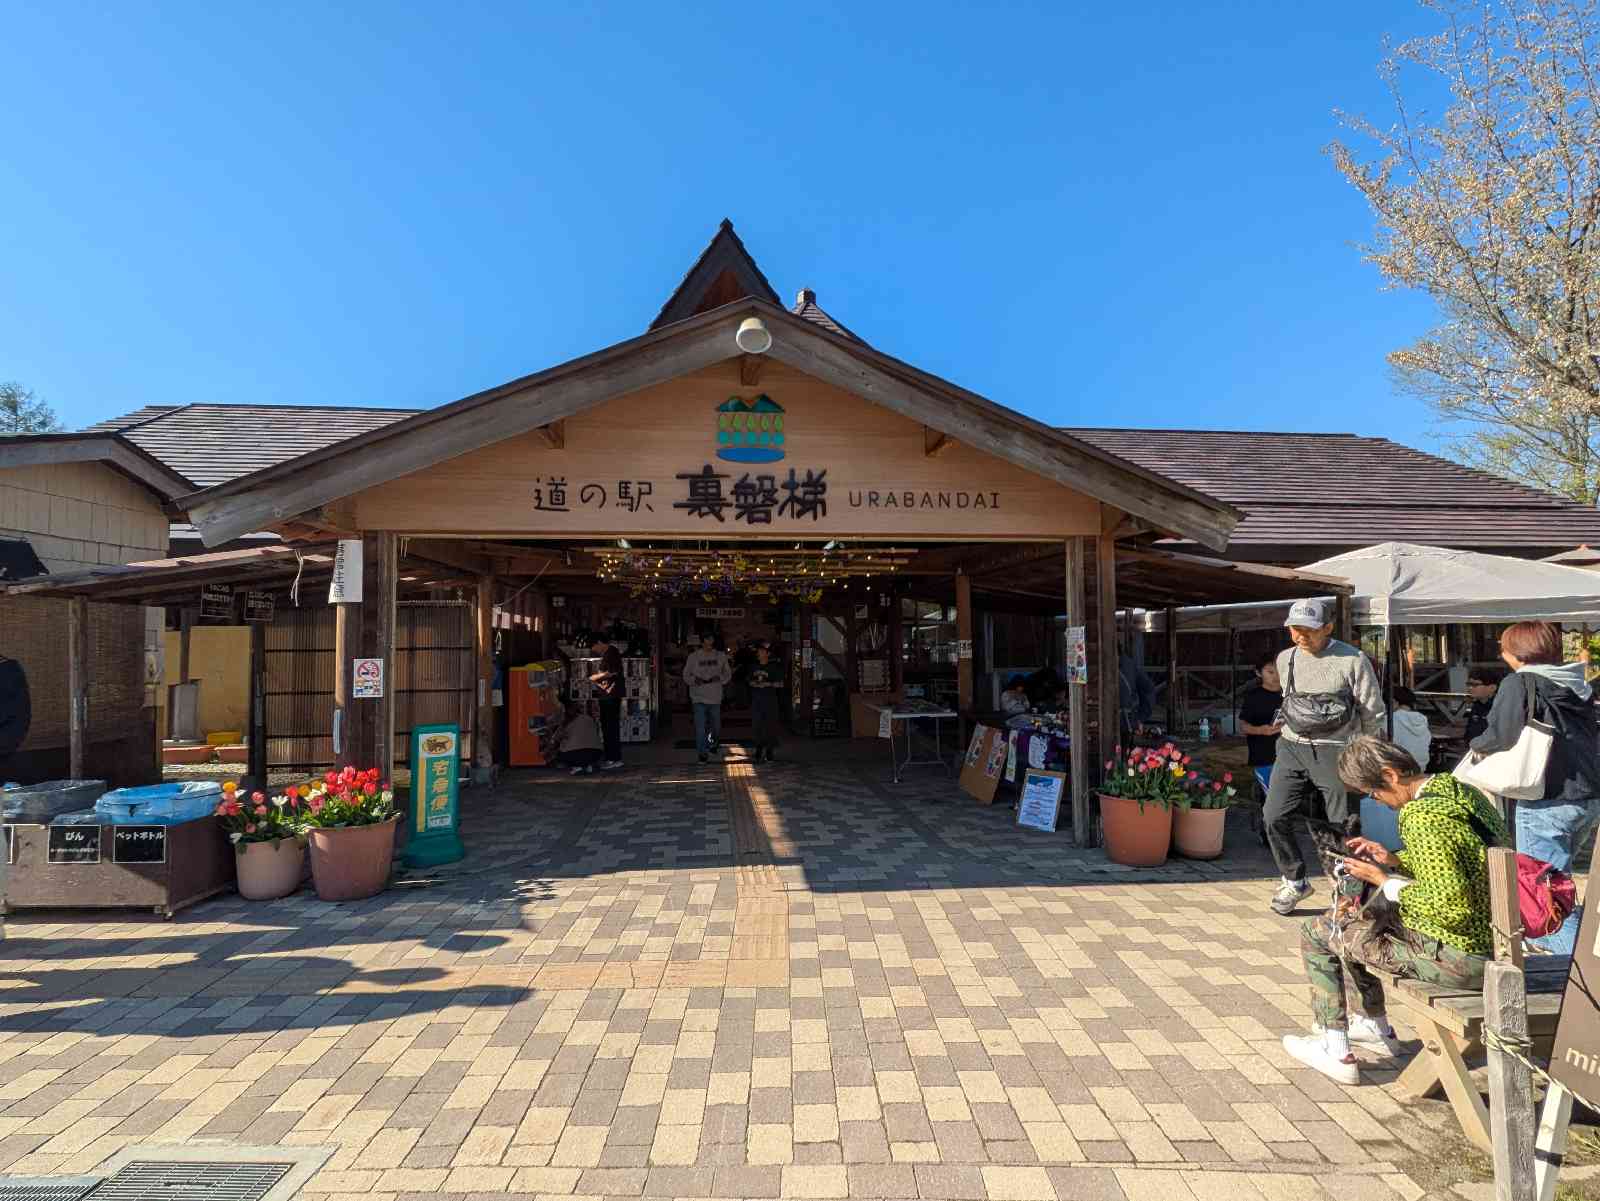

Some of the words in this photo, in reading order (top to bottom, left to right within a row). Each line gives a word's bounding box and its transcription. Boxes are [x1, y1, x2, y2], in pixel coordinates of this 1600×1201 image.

[534, 476, 654, 512] 道の駅
[672, 464, 828, 524] 裏磐梯
[849, 490, 1001, 509] URABANDAI
[116, 831, 165, 841] ペットボトル
[1565, 1047, 1600, 1078] mi
